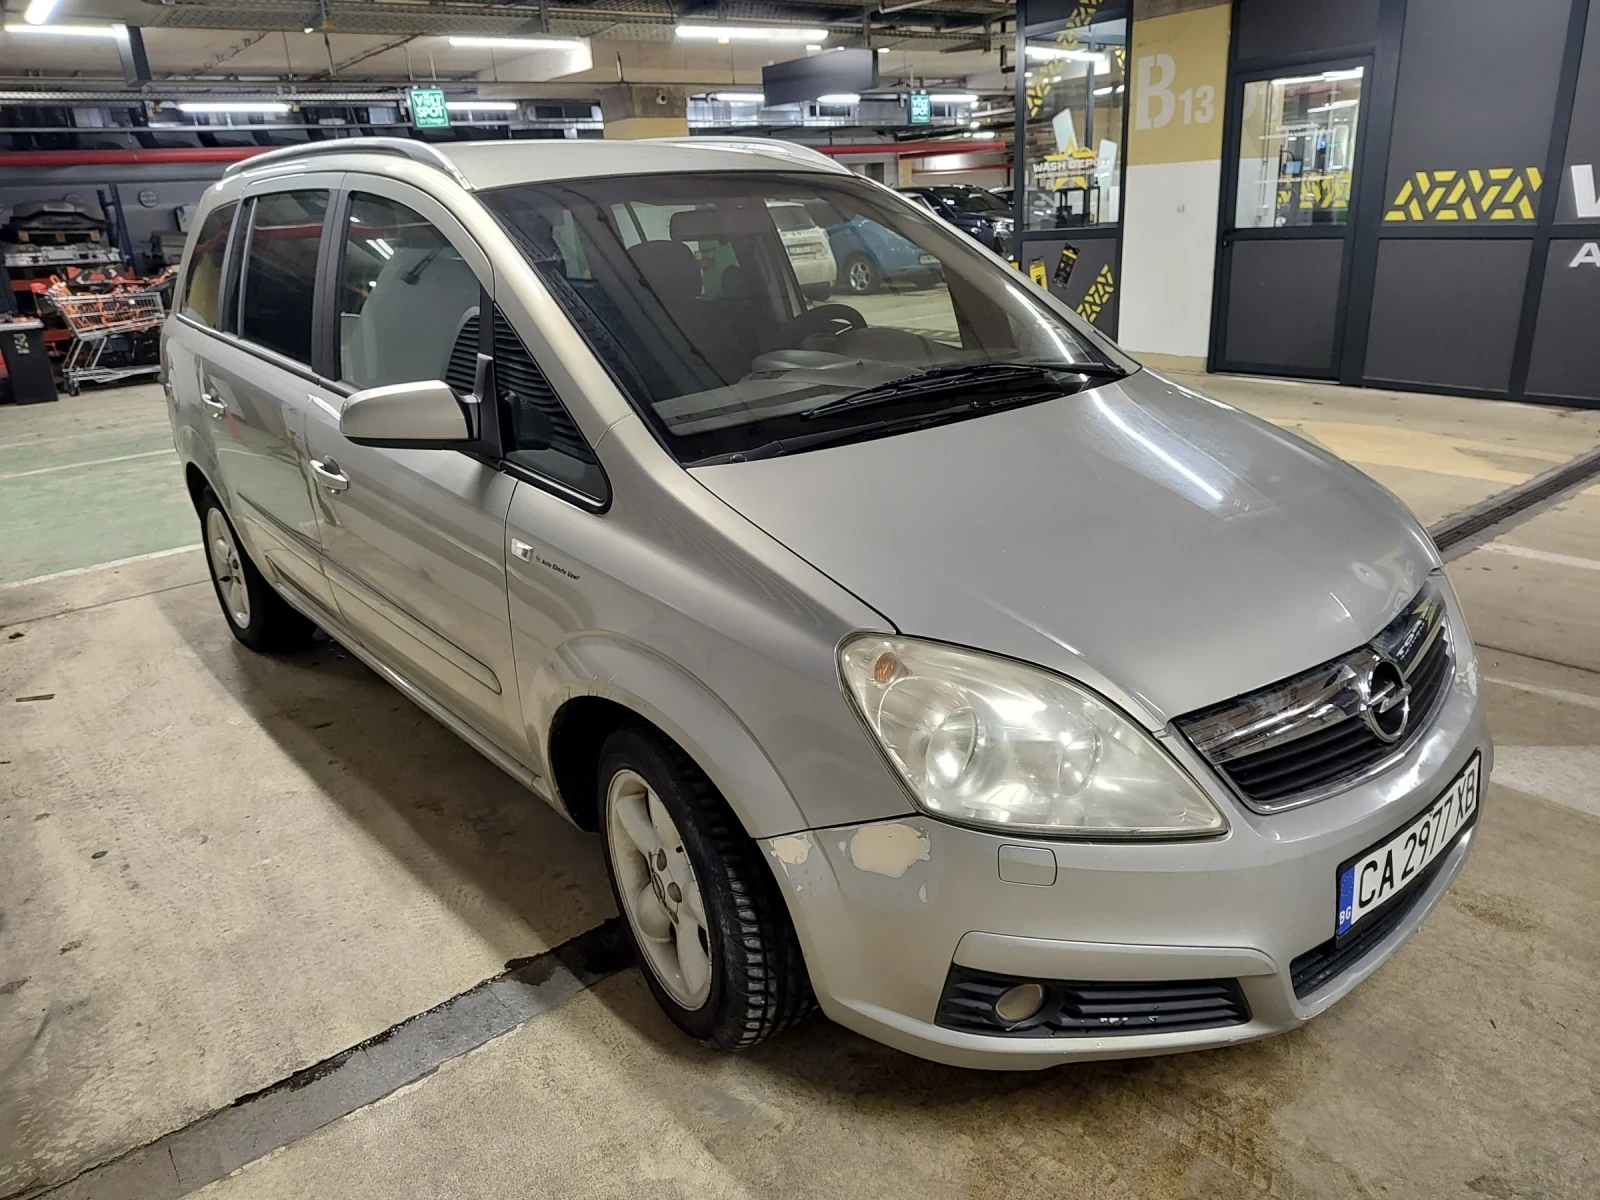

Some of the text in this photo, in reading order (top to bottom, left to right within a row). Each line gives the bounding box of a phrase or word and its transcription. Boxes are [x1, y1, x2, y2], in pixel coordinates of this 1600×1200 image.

[416, 106, 443, 117] SPOT
[1032, 161, 1067, 173] WASH
[541, 559, 552, 567] Auto
[1339, 905, 1352, 925] BG
